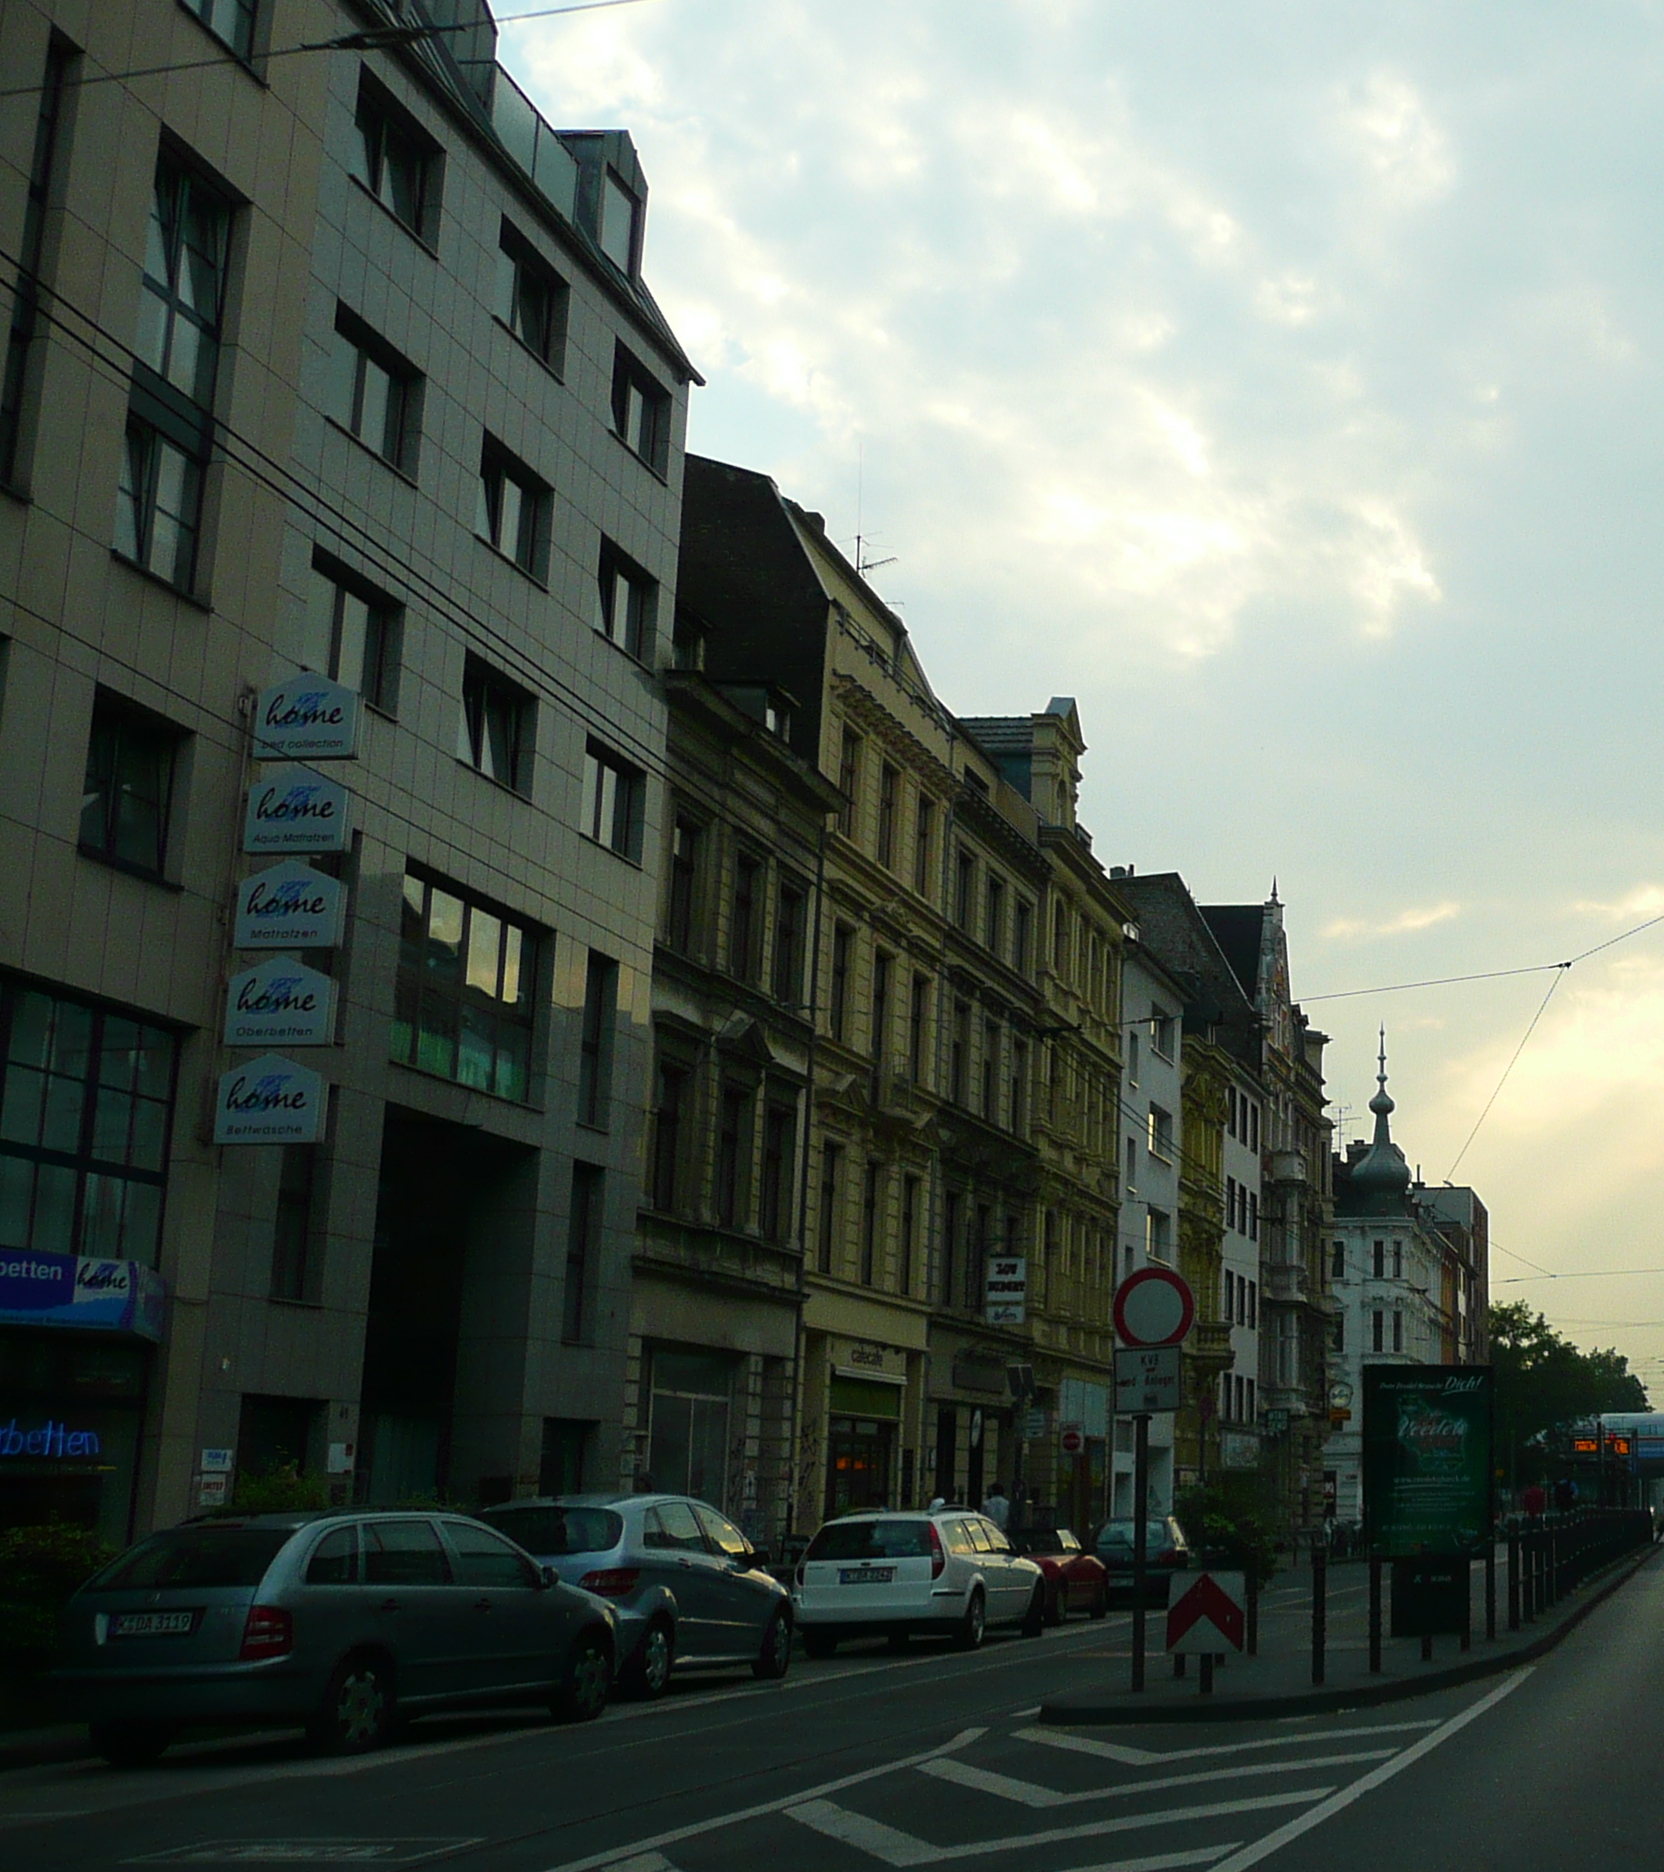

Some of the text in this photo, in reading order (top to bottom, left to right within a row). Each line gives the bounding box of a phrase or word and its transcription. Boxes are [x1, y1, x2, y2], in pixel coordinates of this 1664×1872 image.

[266, 694, 344, 726] home
[287, 739, 344, 749] collection
[256, 787, 334, 819] home
[253, 833, 335, 845] Aqua Matratzen
[247, 882, 326, 914] home
[251, 928, 318, 939] Matratzen
[237, 978, 316, 1011] home
[236, 1026, 313, 1037] Oberbetten
[226, 1076, 307, 1110] home
[77, 1262, 128, 1289] home
[1443, 1375, 1484, 1391] Dich!
